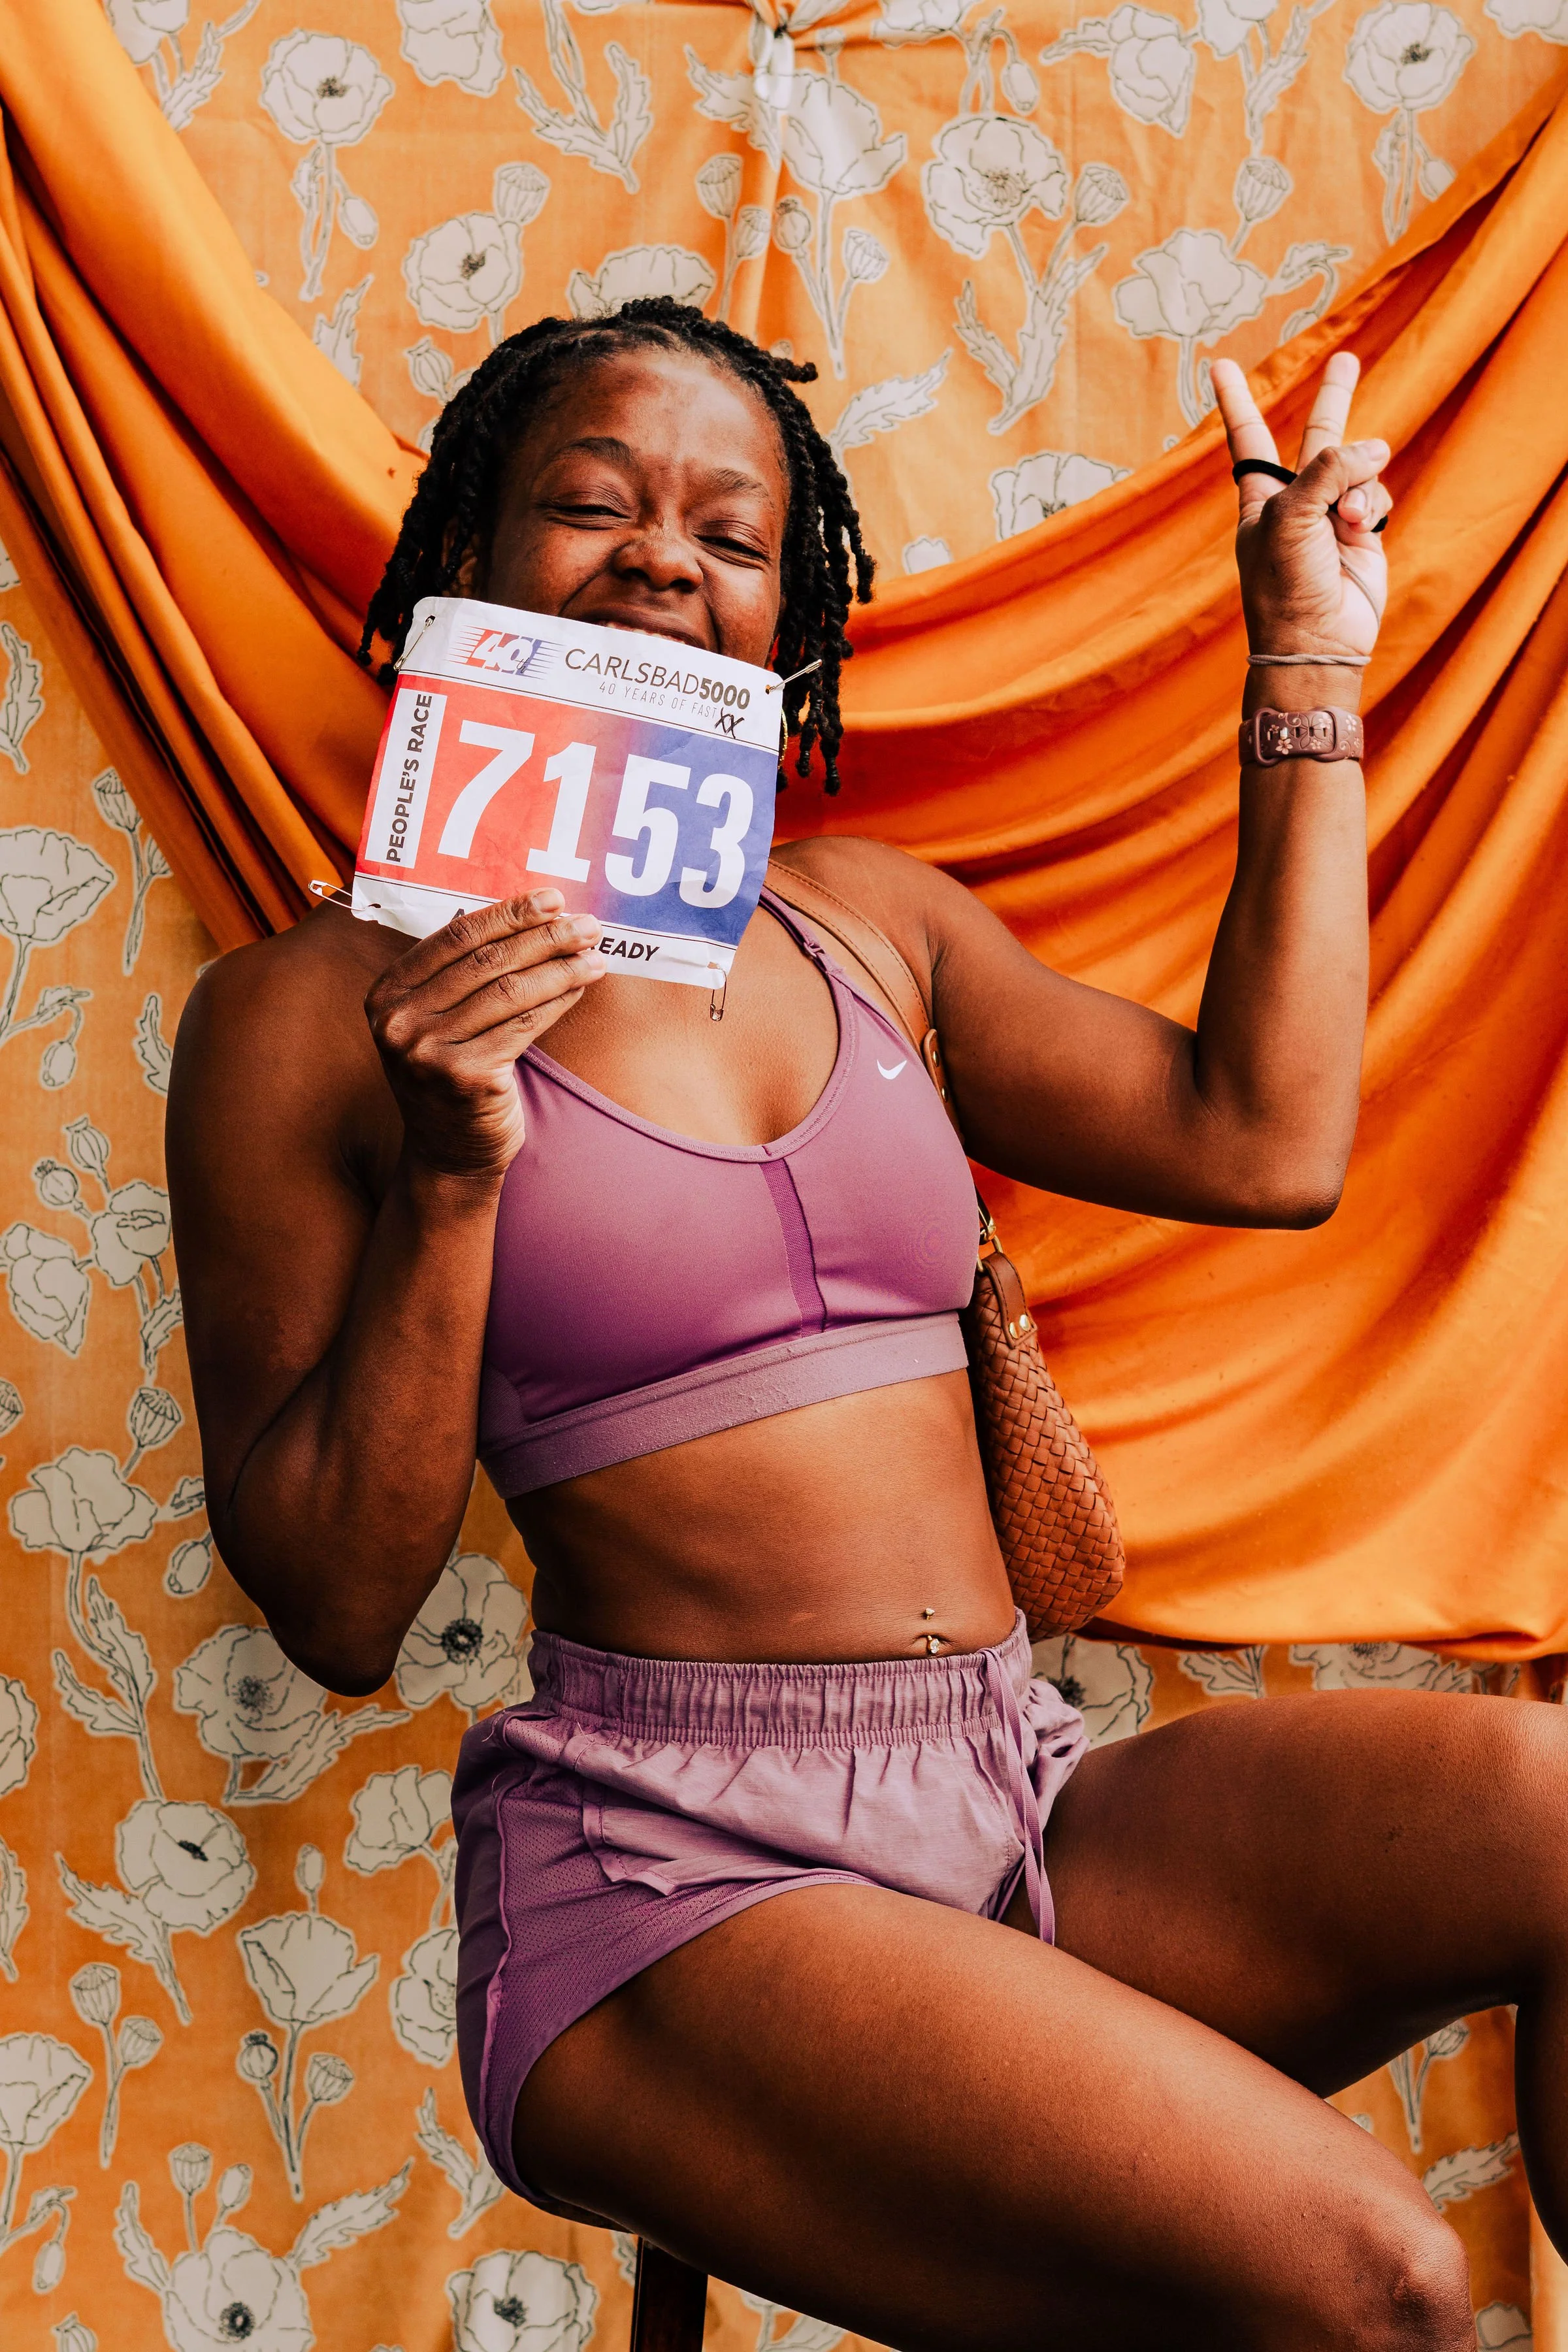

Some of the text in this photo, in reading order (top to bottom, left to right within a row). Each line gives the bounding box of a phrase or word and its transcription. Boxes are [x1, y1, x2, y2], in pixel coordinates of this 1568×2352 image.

[565, 648, 750, 710] CARLSBAD5000
[599, 681, 717, 719] 40 YEARS OF FAST
[407, 694, 433, 753] RACE
[437, 720, 754, 909] 7153
[590, 937, 660, 961] EADY
